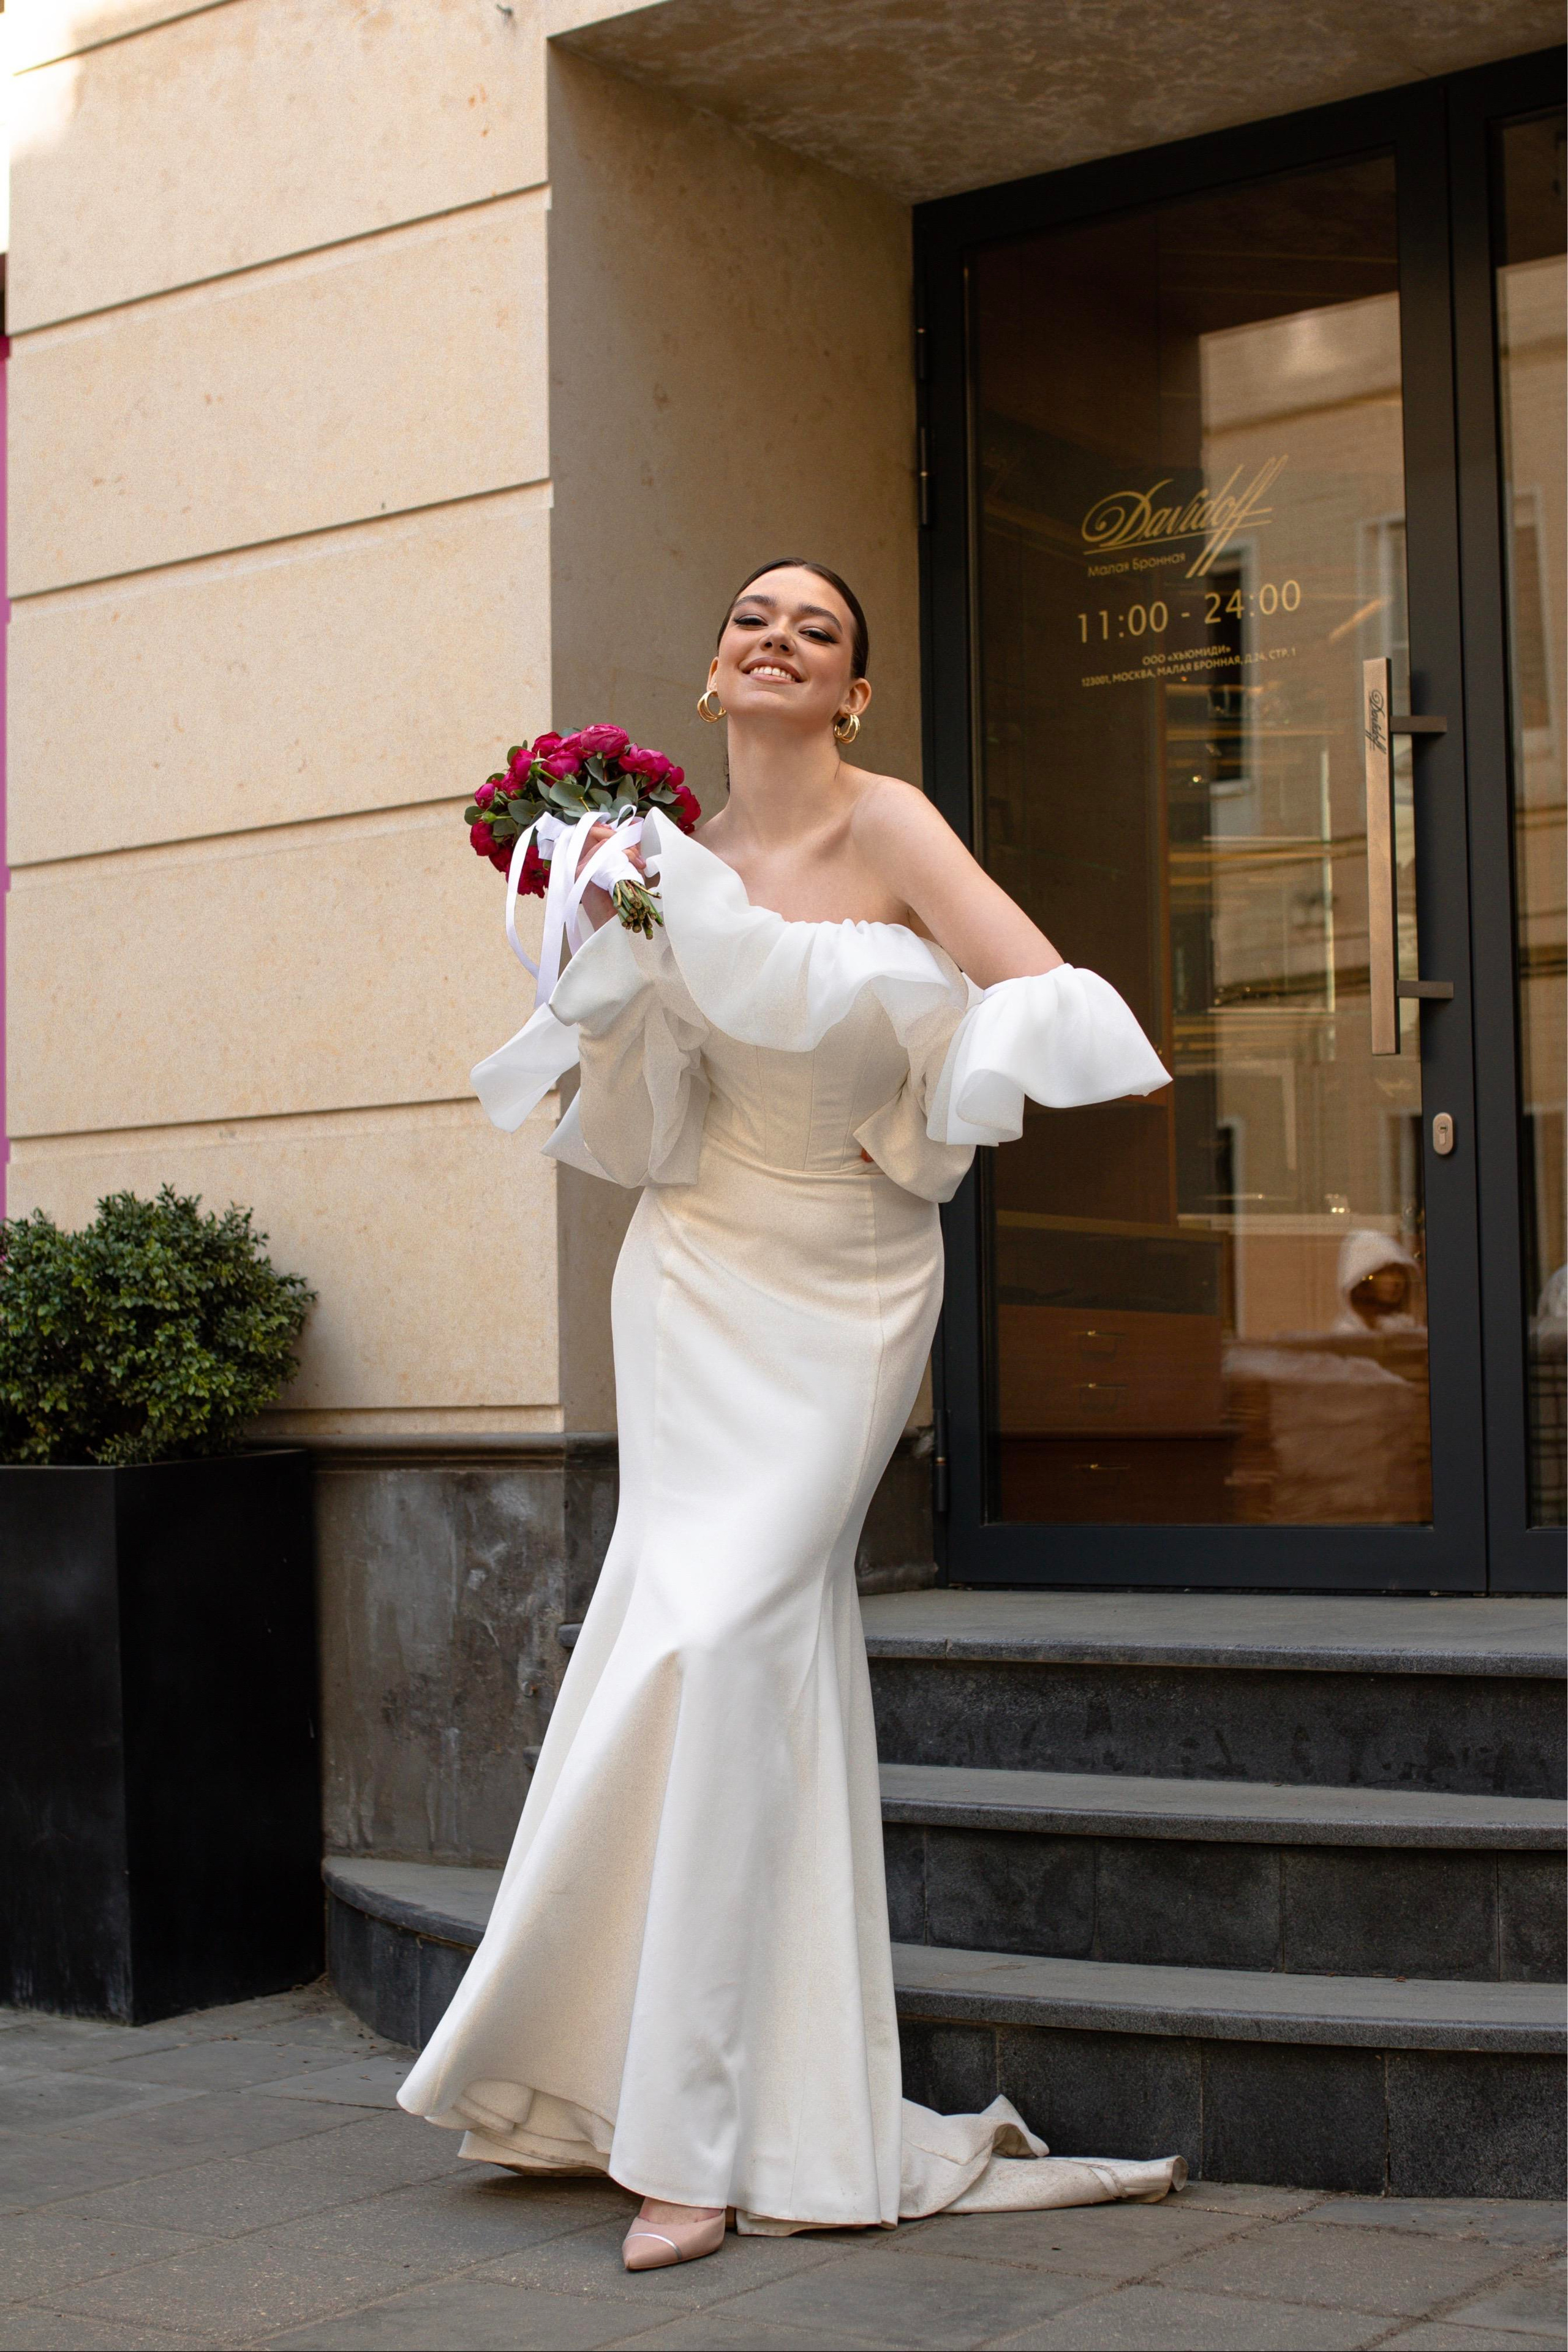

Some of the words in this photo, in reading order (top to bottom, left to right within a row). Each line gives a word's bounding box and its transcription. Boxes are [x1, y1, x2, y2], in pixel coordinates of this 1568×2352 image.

[1082, 454, 1288, 578] Davidoff
[1088, 562, 1129, 577] Малая
[1133, 552, 1186, 571] Бронная
[1078, 601, 1168, 643] 11:00
[1204, 579, 1301, 624] 24:00
[1142, 654, 1166, 665] ООО
[1157, 662, 1192, 676] МАЛАЯ
[1365, 690, 1387, 755] Davidoff
